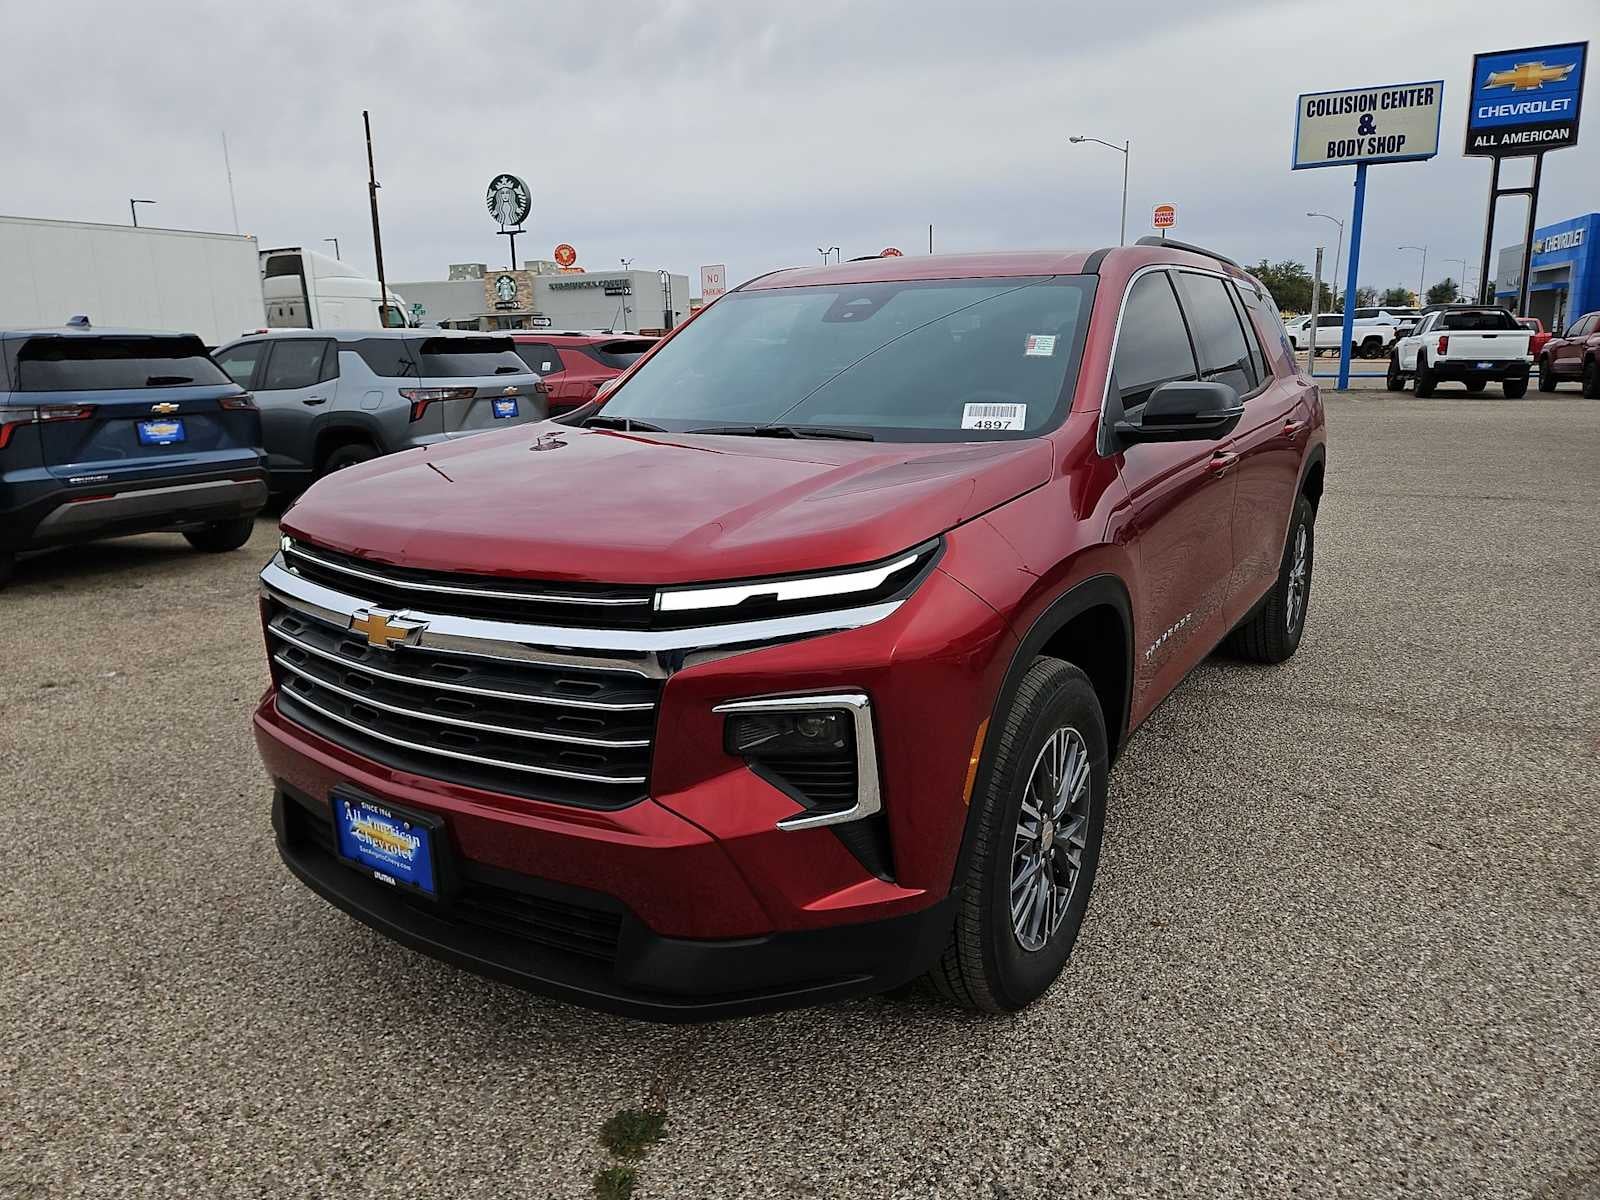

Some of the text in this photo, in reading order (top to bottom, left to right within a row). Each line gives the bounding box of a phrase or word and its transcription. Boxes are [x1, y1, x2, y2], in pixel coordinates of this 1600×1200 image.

[1306, 88, 1434, 117] COLLISION CENTER
[1478, 98, 1571, 118] CHEVROLET
[1358, 113, 1376, 136] &
[1327, 135, 1405, 158] BODY SHOP
[1474, 128, 1570, 147] ALL AMERICAN
[1544, 228, 1585, 252] CHEVROLET
[707, 274, 719, 283] NO
[974, 420, 1012, 429] 4897
[361, 802, 378, 814] SINCE
[345, 808, 421, 848] All American
[356, 829, 413, 862] Chevrolet
